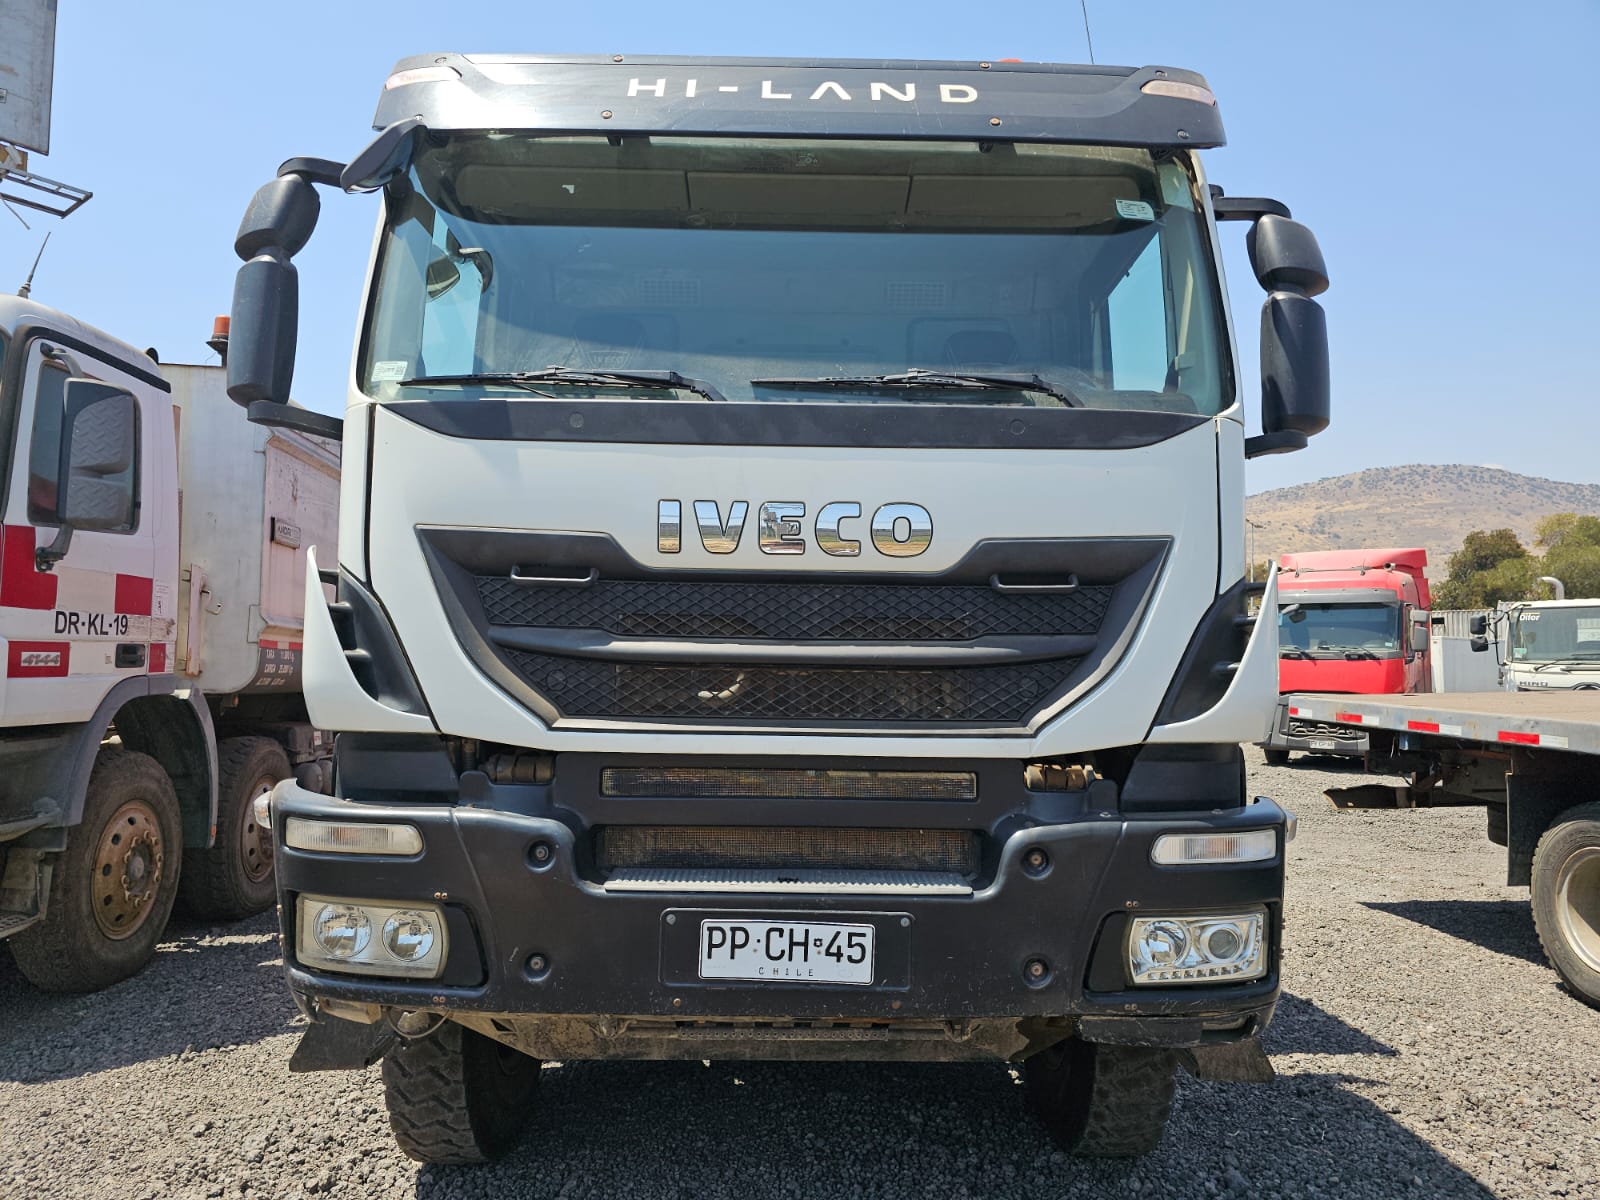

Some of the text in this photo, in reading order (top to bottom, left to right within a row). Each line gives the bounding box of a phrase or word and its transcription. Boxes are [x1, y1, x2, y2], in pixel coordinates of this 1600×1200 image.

[627, 78, 978, 103] HI-LAND
[657, 498, 934, 558] IVECO
[22, 653, 60, 665] 4144
[758, 966, 814, 977] CHILE
